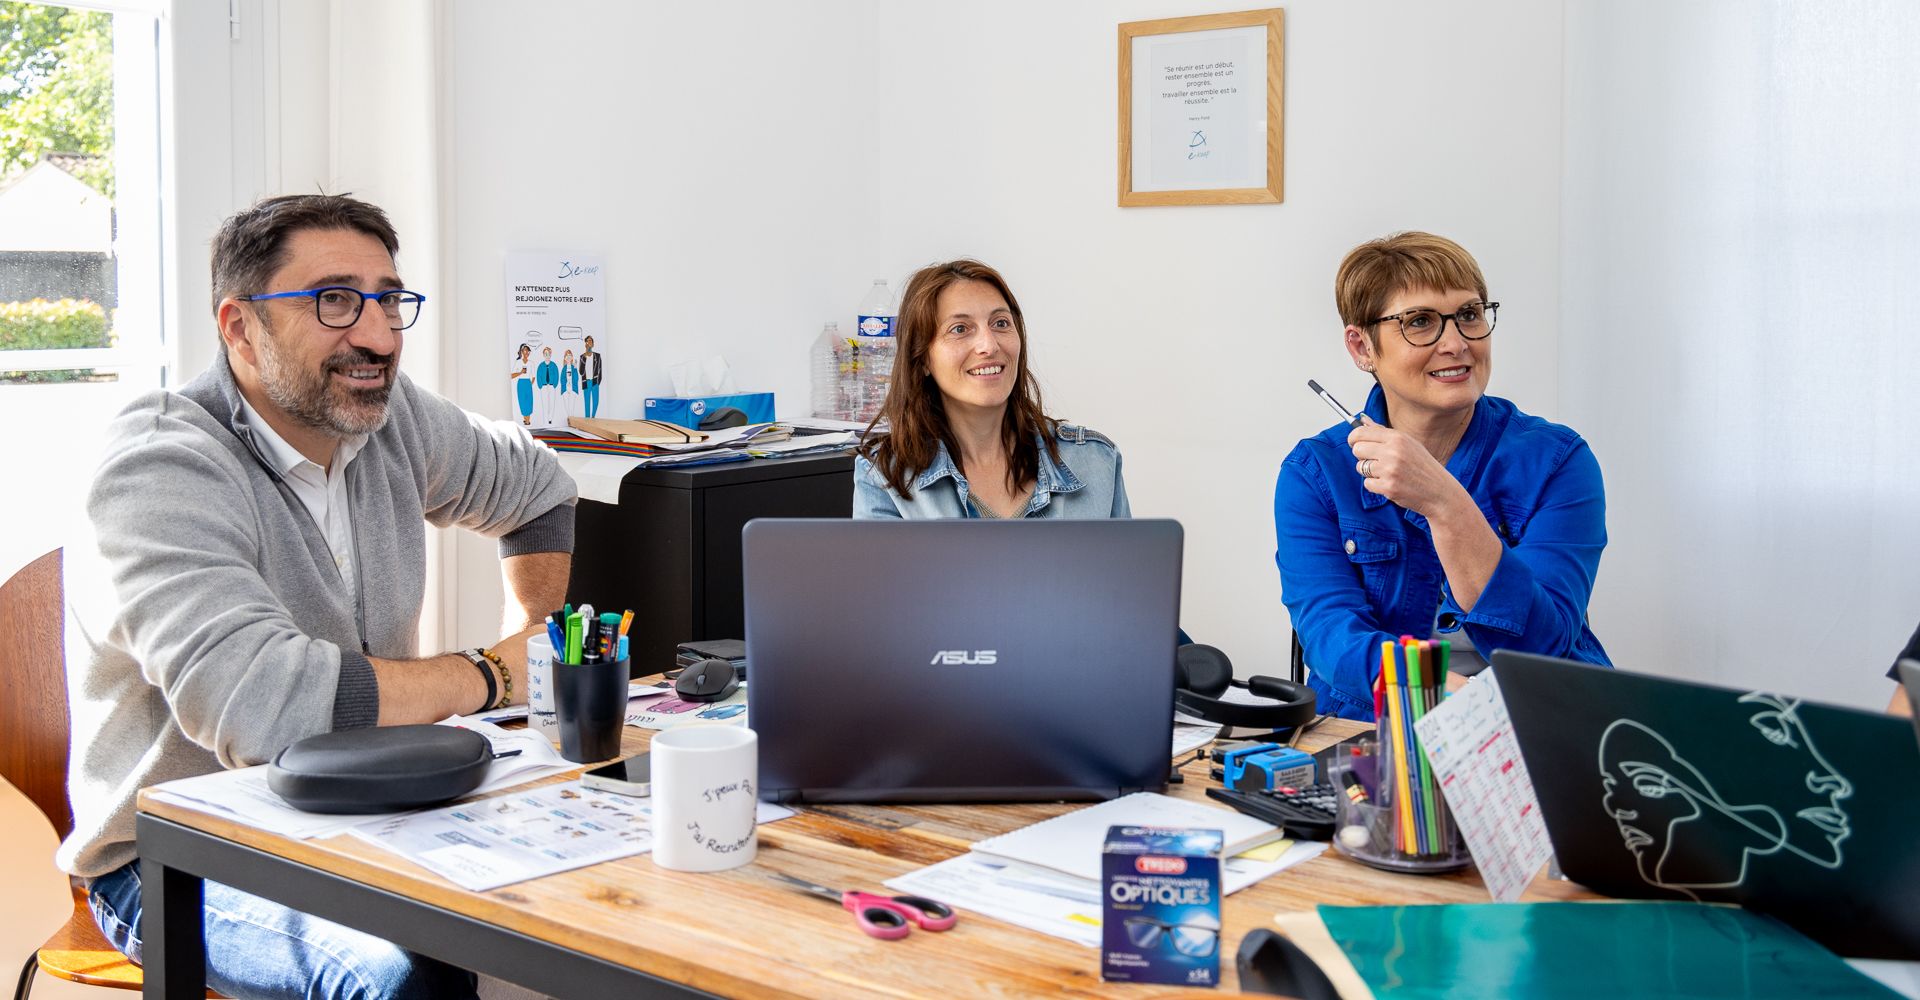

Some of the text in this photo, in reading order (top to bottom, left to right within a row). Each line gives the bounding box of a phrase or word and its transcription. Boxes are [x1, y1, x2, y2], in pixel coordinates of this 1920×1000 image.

[1175, 64, 1193, 72] réunir
[1184, 71, 1213, 80] ensemble
[1162, 90, 1188, 98] travailler
[1190, 88, 1219, 97] ensemble
[515, 285, 555, 293] N'ATTENDEZ
[930, 650, 997, 665] ASUS
[1110, 882, 1210, 906] OPTIQUES
